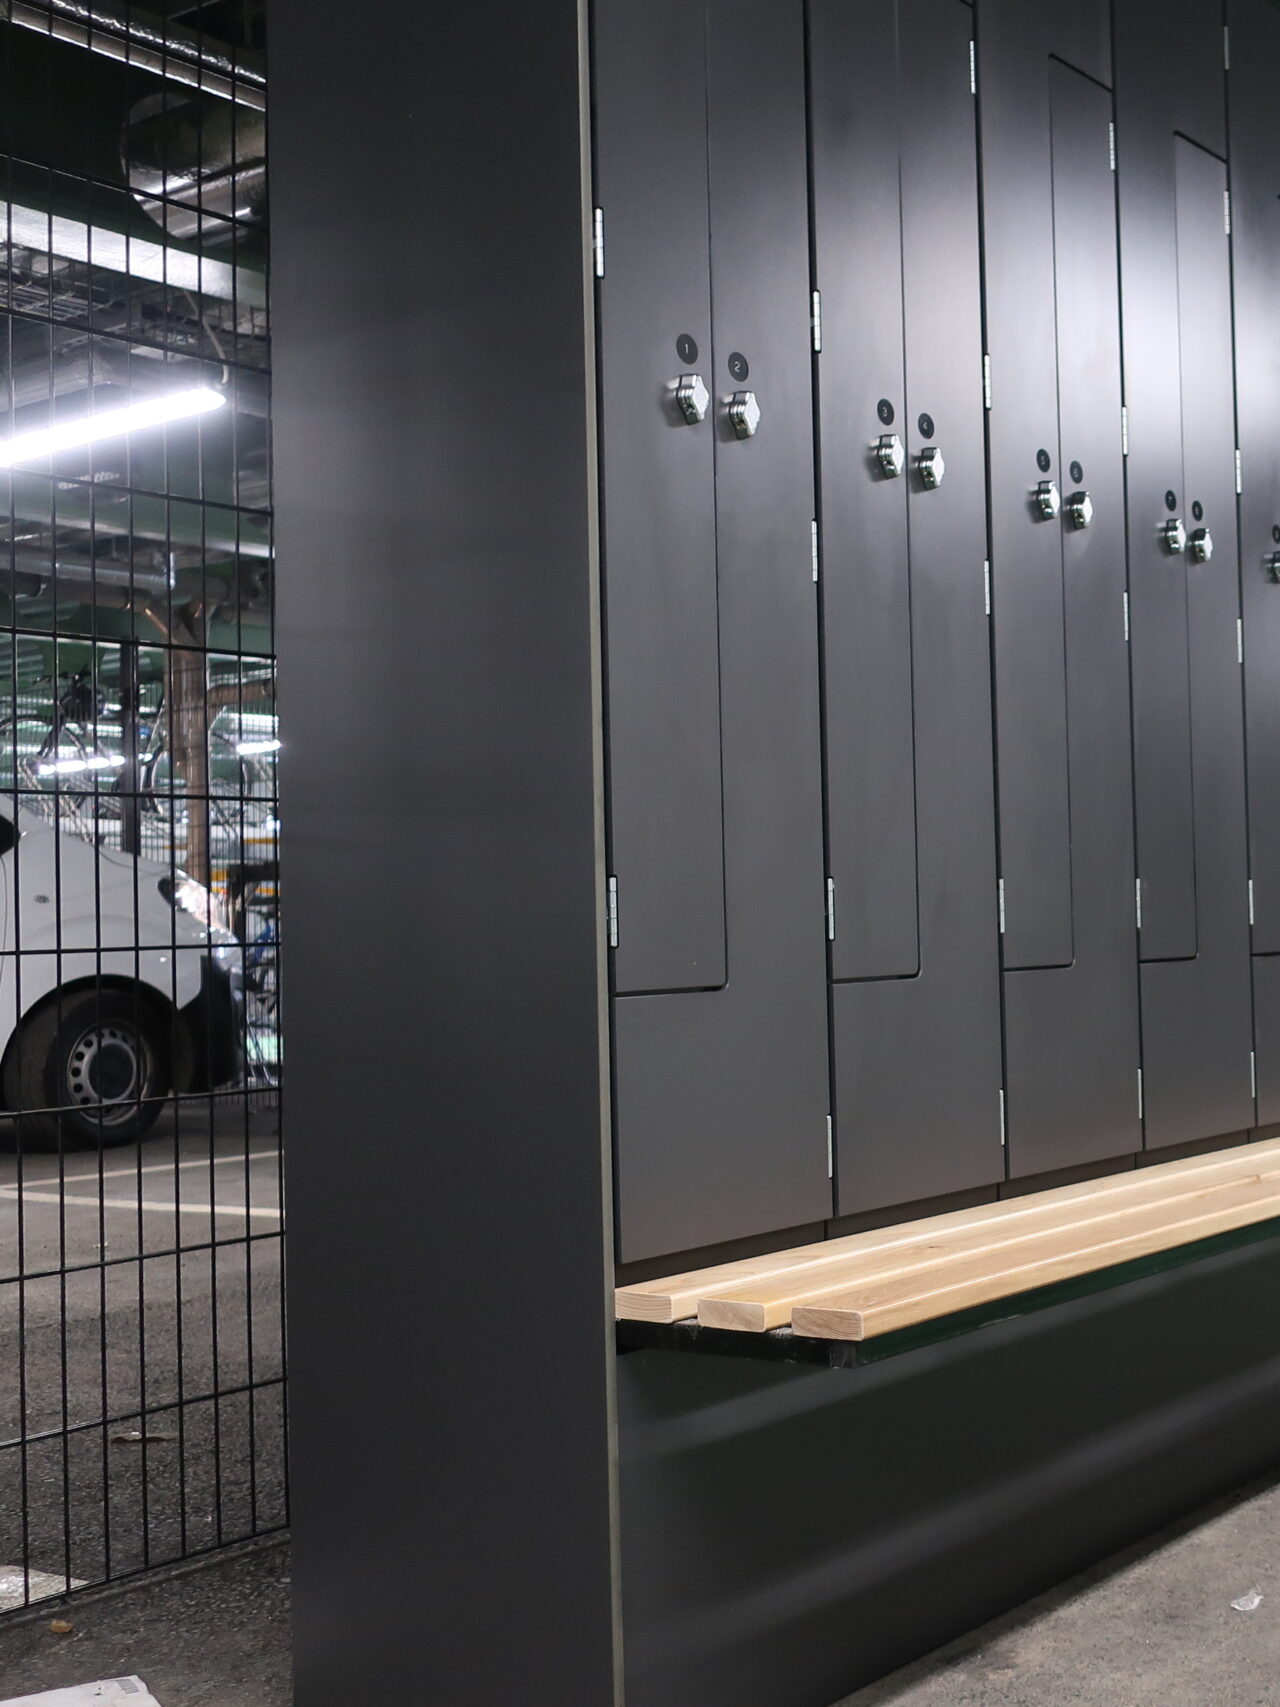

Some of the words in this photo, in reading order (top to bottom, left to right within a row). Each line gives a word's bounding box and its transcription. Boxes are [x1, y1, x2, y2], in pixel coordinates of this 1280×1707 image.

[684, 343, 689, 354] 1
[734, 361, 741, 373] 2
[882, 406, 888, 417] 3
